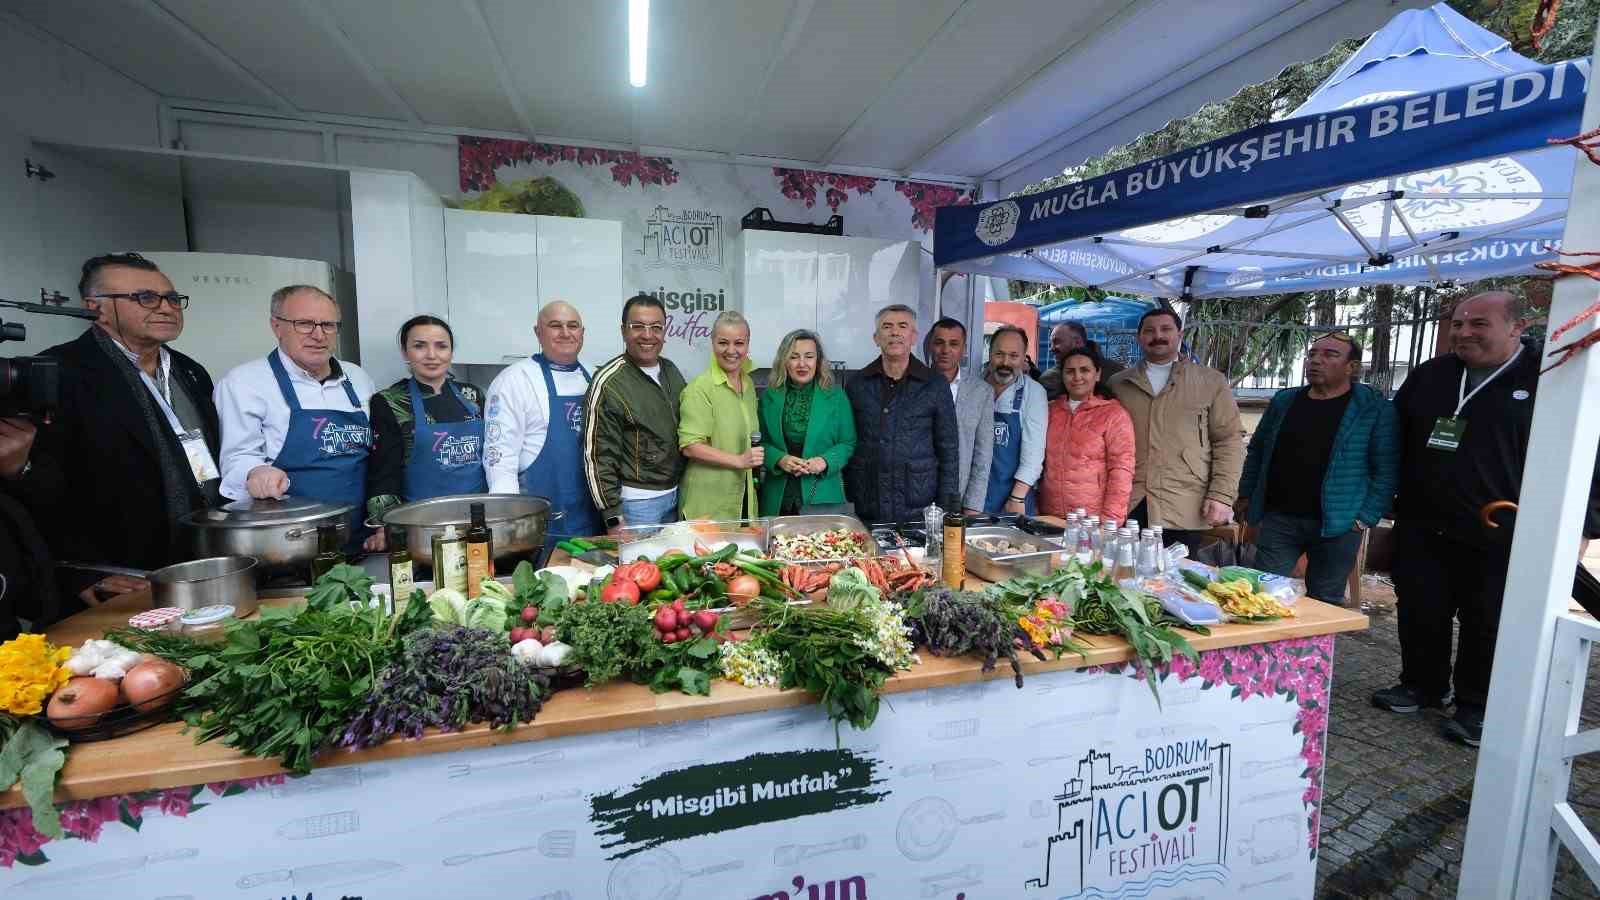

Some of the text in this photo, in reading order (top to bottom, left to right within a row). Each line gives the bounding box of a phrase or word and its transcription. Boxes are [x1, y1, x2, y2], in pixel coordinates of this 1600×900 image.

[1029, 178, 1119, 222] MUĞLA
[1126, 114, 1357, 197] BÜYÜKŞEHİR
[682, 209, 712, 221] BODRUM
[312, 416, 328, 440] 7
[432, 431, 448, 452] 7
[1145, 738, 1208, 773] BODRUM
